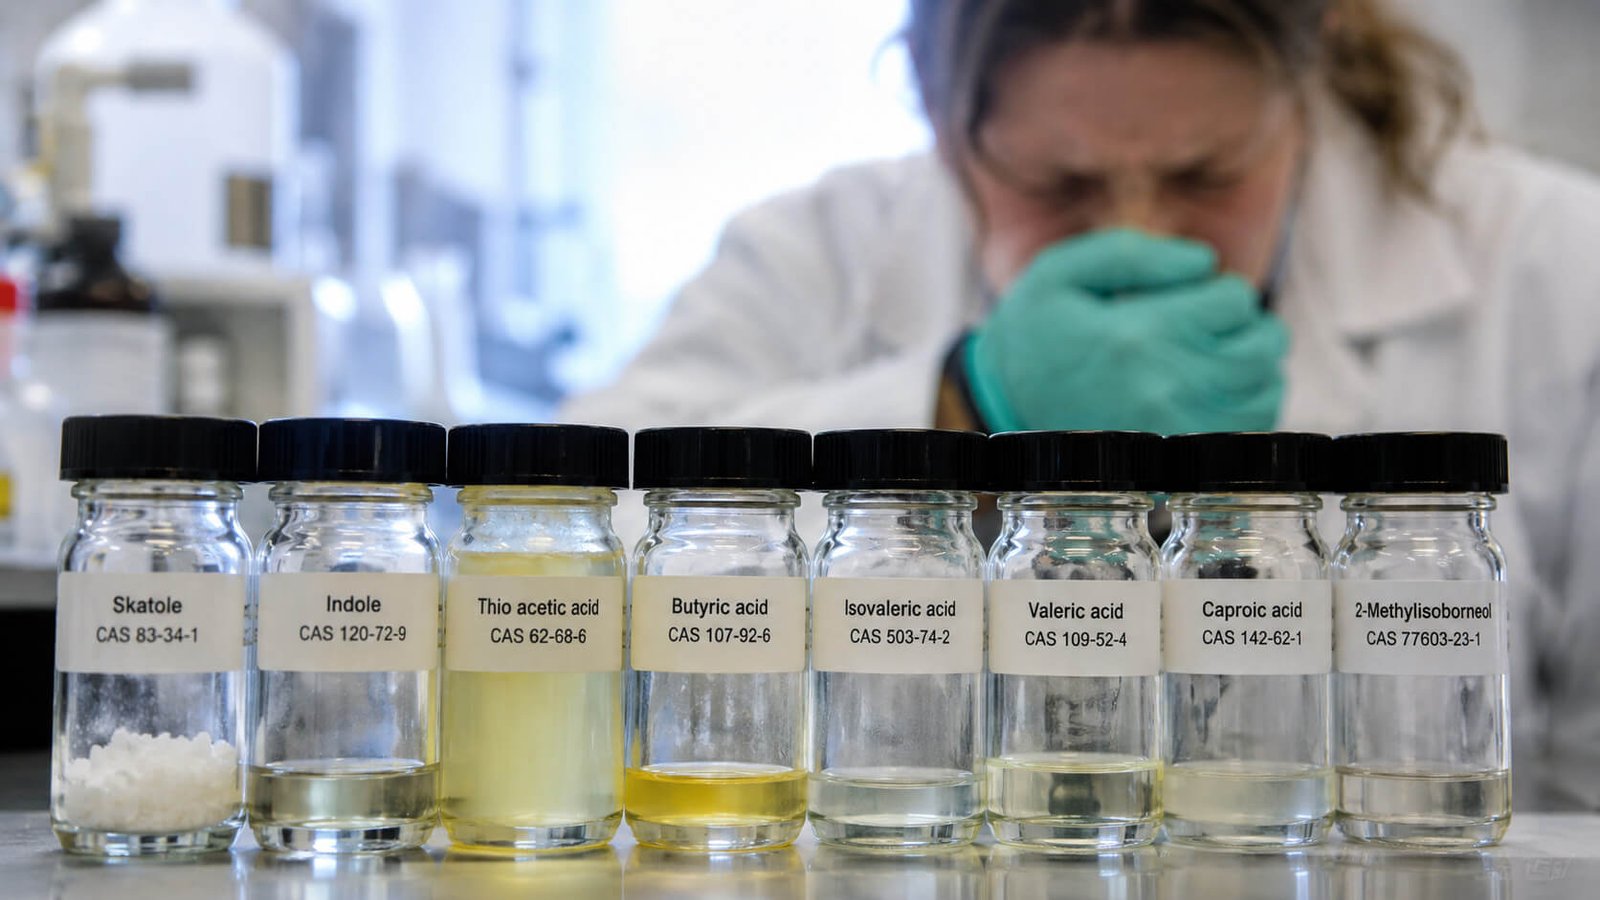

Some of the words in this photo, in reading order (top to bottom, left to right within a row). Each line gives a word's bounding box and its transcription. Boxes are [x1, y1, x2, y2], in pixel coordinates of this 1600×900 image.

[112, 595, 183, 615] Skatole
[326, 594, 382, 613] Indole
[477, 597, 512, 616] Thio
[516, 598, 567, 616] acetic
[570, 598, 600, 616] acid
[671, 597, 731, 620] Butyric
[734, 598, 769, 616] acid
[844, 598, 922, 617] Isovaleric
[925, 599, 956, 617] acid
[1028, 601, 1086, 620] Valeric
[1090, 602, 1124, 620] acid
[1202, 600, 1267, 622] Caproic
[1271, 600, 1303, 619] acid
[1355, 601, 1492, 624] 2-Methylisoborneol
[96, 626, 131, 644] CAS
[135, 626, 198, 644] 83-34-1
[299, 624, 334, 642] CAS
[340, 625, 407, 642] 120-72-9
[490, 627, 525, 644] CAS
[528, 627, 587, 644] 62-68-6
[668, 626, 701, 643] CAS
[705, 626, 771, 644] 107-92-6
[849, 627, 882, 645] CAS
[886, 628, 950, 645] 503-74-2
[1024, 630, 1057, 647] CAS
[1062, 631, 1128, 648] 109-52-4
[1202, 629, 1236, 646] CAS
[1240, 630, 1302, 646] 142-62-1
[1366, 630, 1397, 647] CAS
[1401, 631, 1481, 647] 77603-23-1
